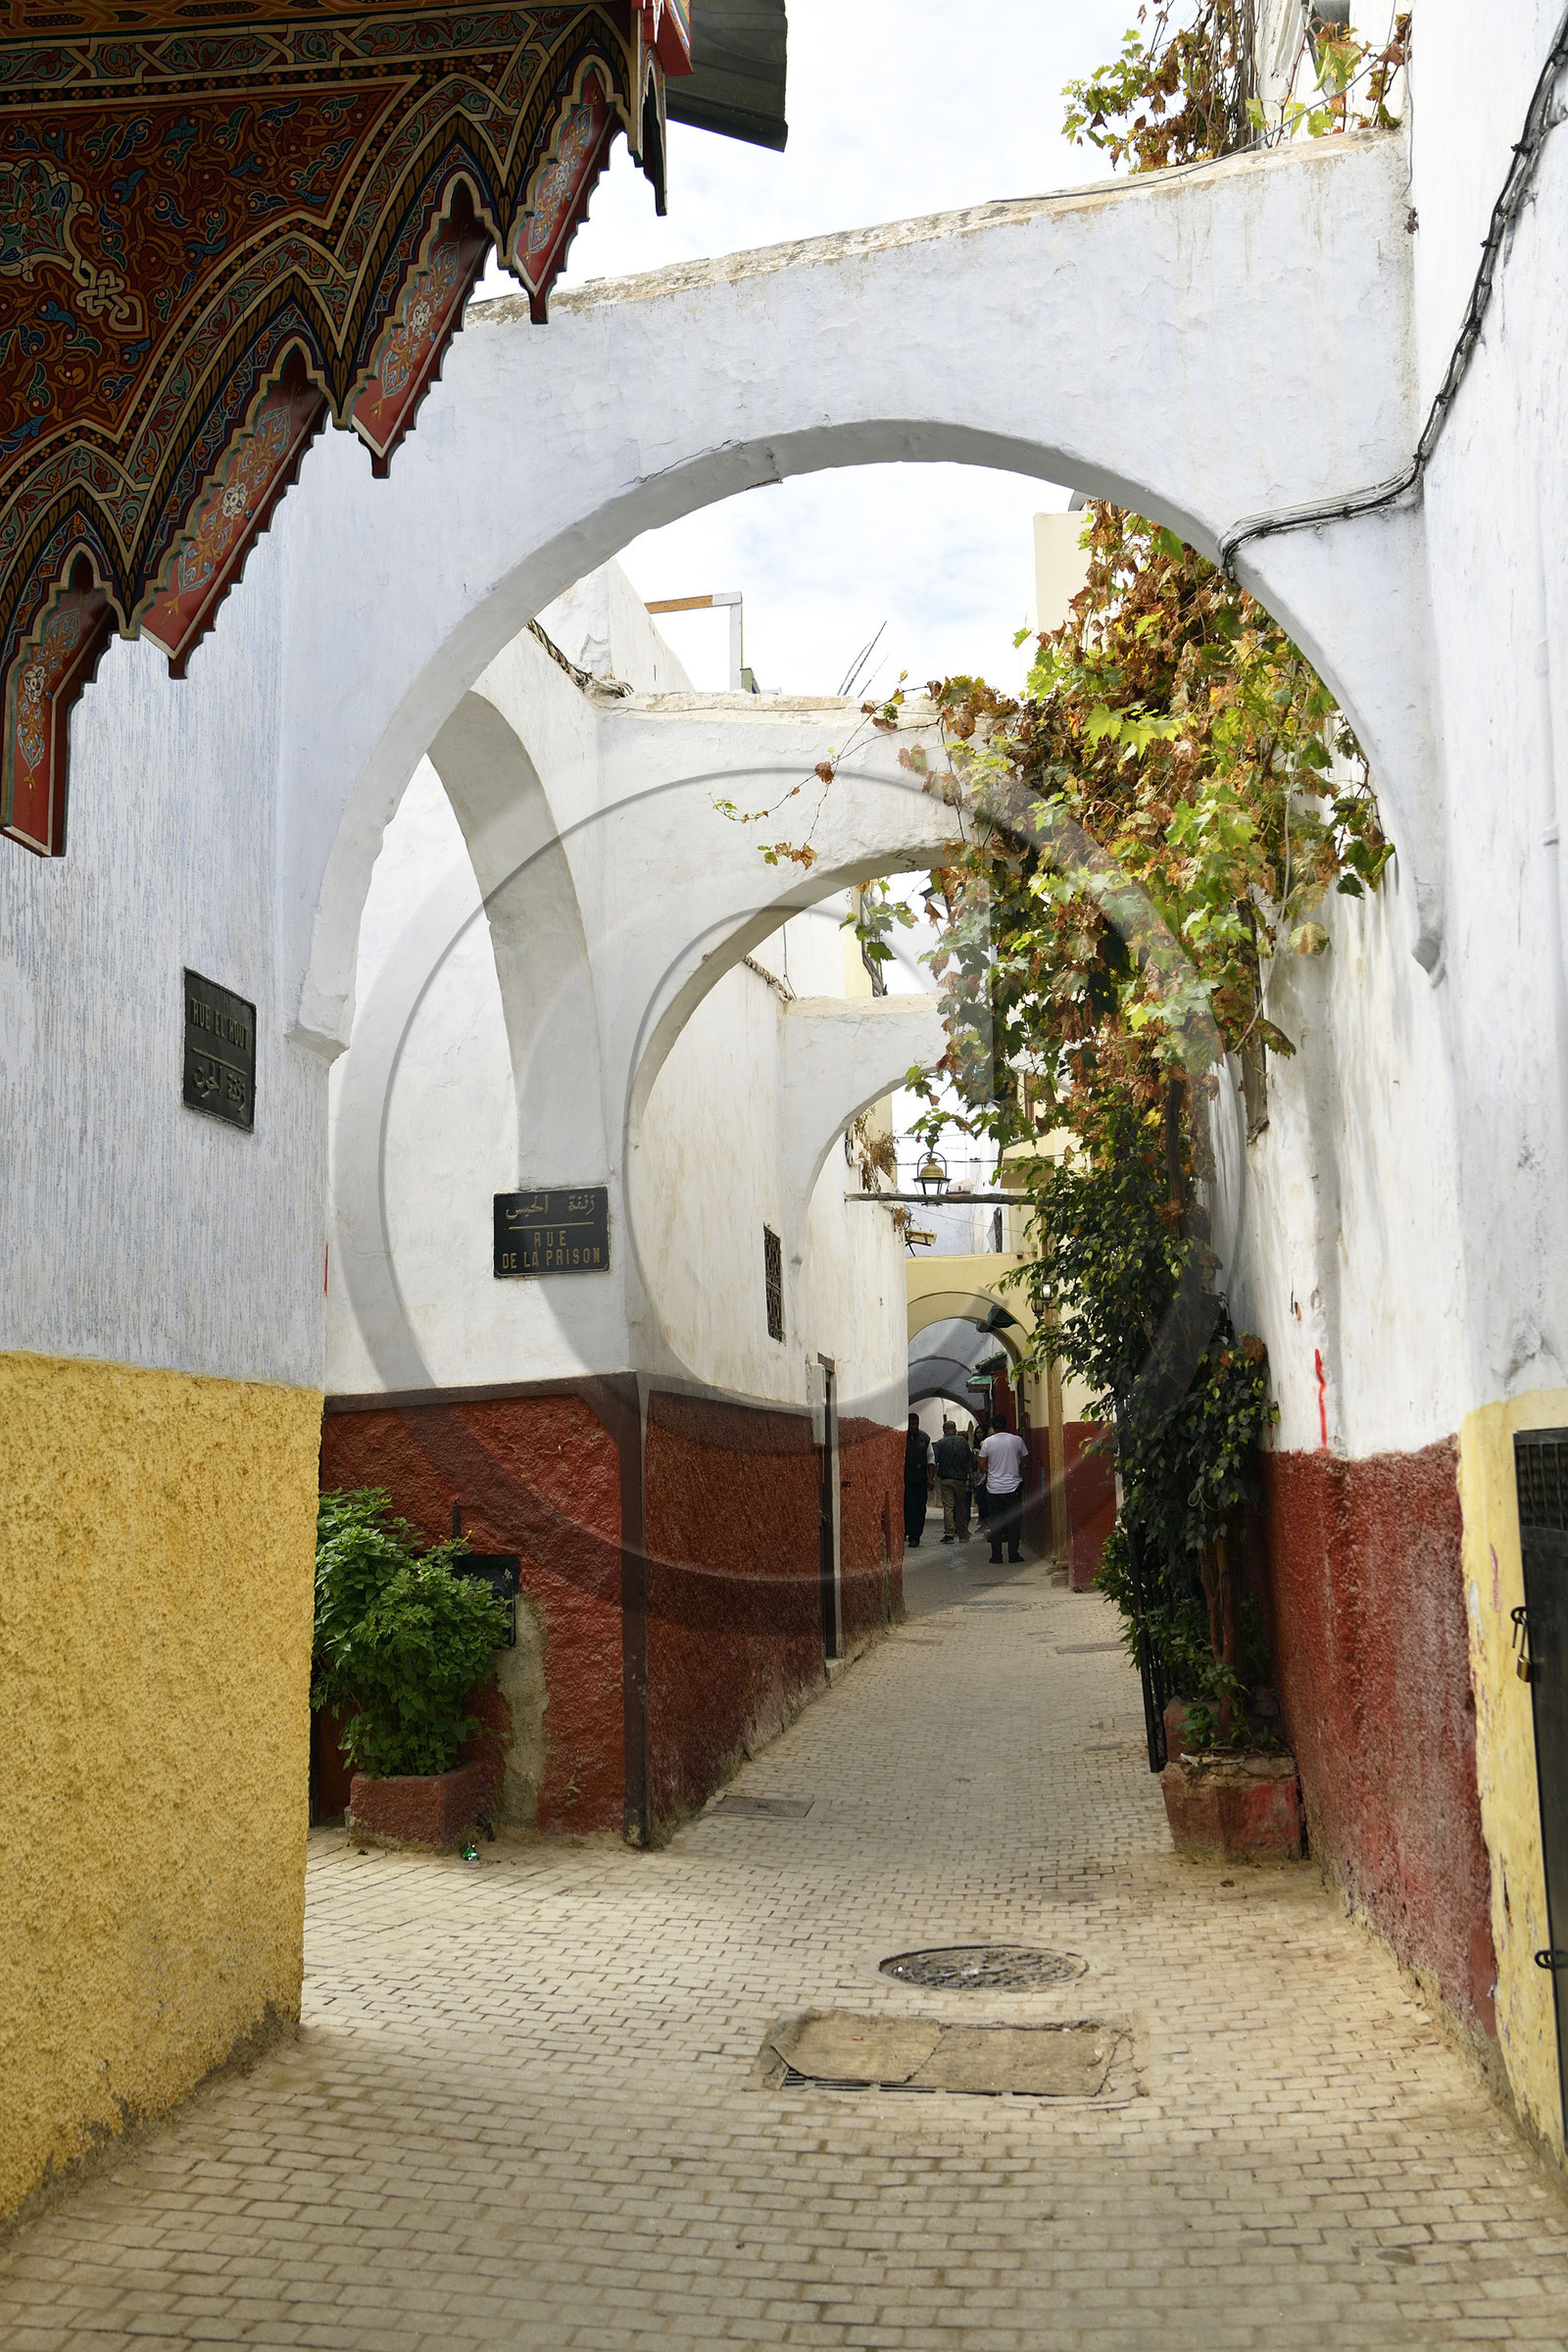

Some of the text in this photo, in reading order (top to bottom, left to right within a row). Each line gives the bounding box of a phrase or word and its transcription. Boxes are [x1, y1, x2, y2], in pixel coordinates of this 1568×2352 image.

[191, 998, 249, 1050] RUE EL HOUT
[226, 1073, 246, 1113] زنقة
[506, 1194, 596, 1220] زنقة الحبس
[534, 1230, 567, 1248] RUE
[502, 1248, 601, 1269] DE LA PRISON
